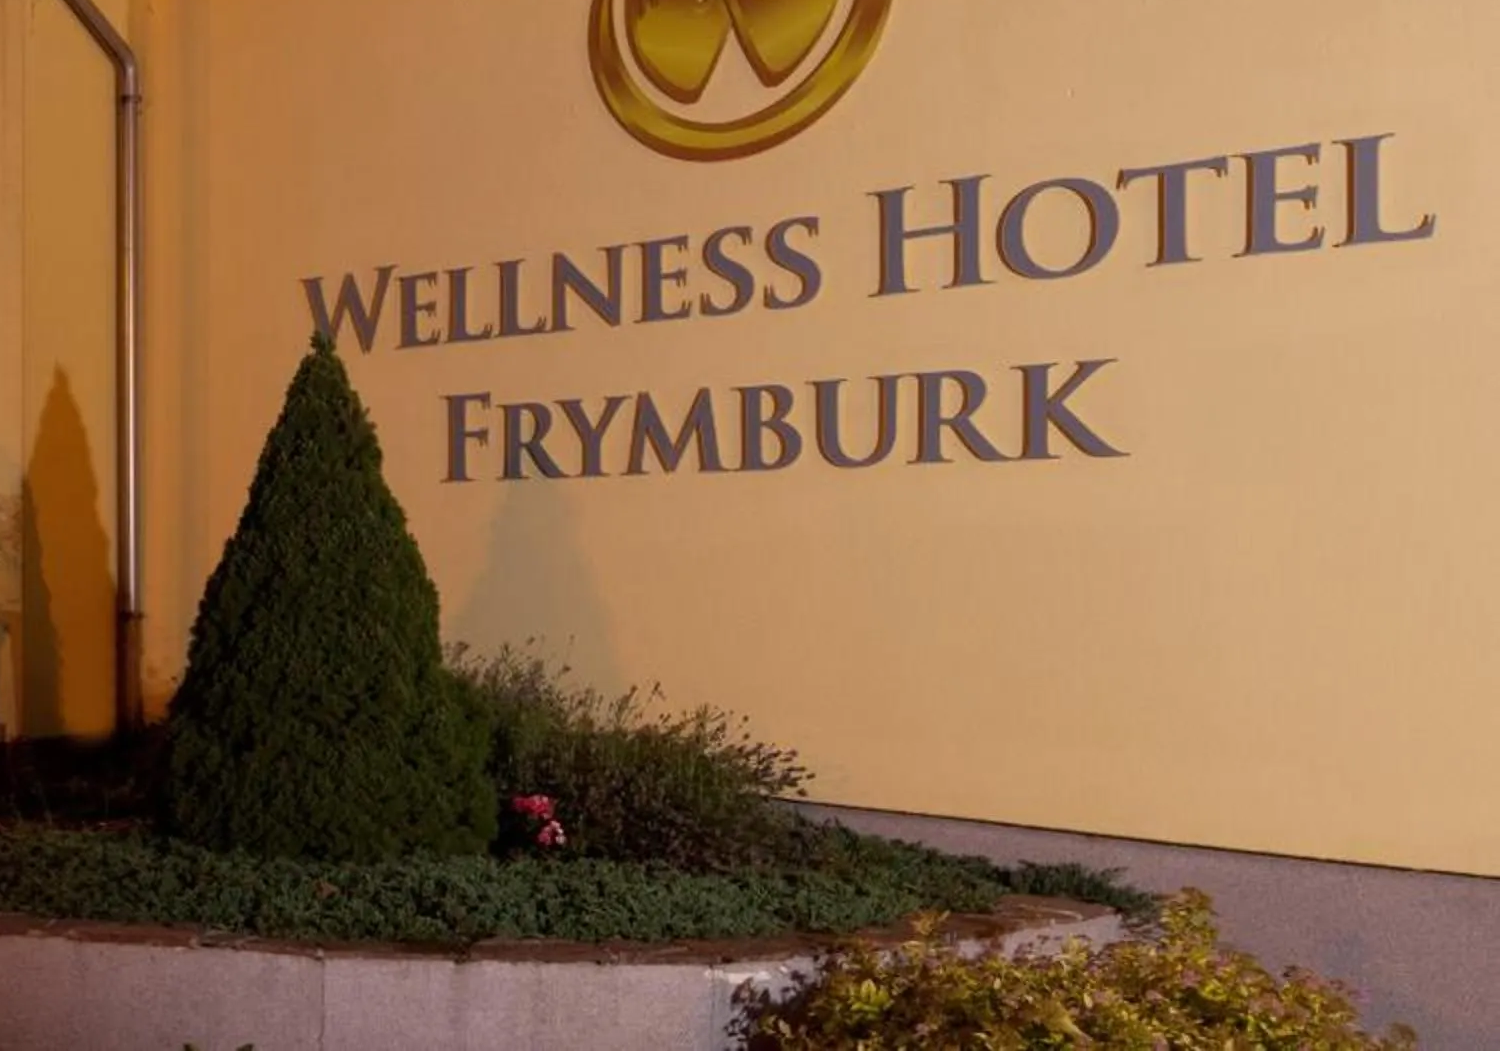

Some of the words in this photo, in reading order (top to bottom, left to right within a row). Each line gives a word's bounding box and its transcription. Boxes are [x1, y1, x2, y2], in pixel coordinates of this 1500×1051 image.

[299, 216, 823, 355] WELLNESS
[866, 133, 1436, 298] HOTEL
[439, 358, 1131, 484] FRYMBURK
